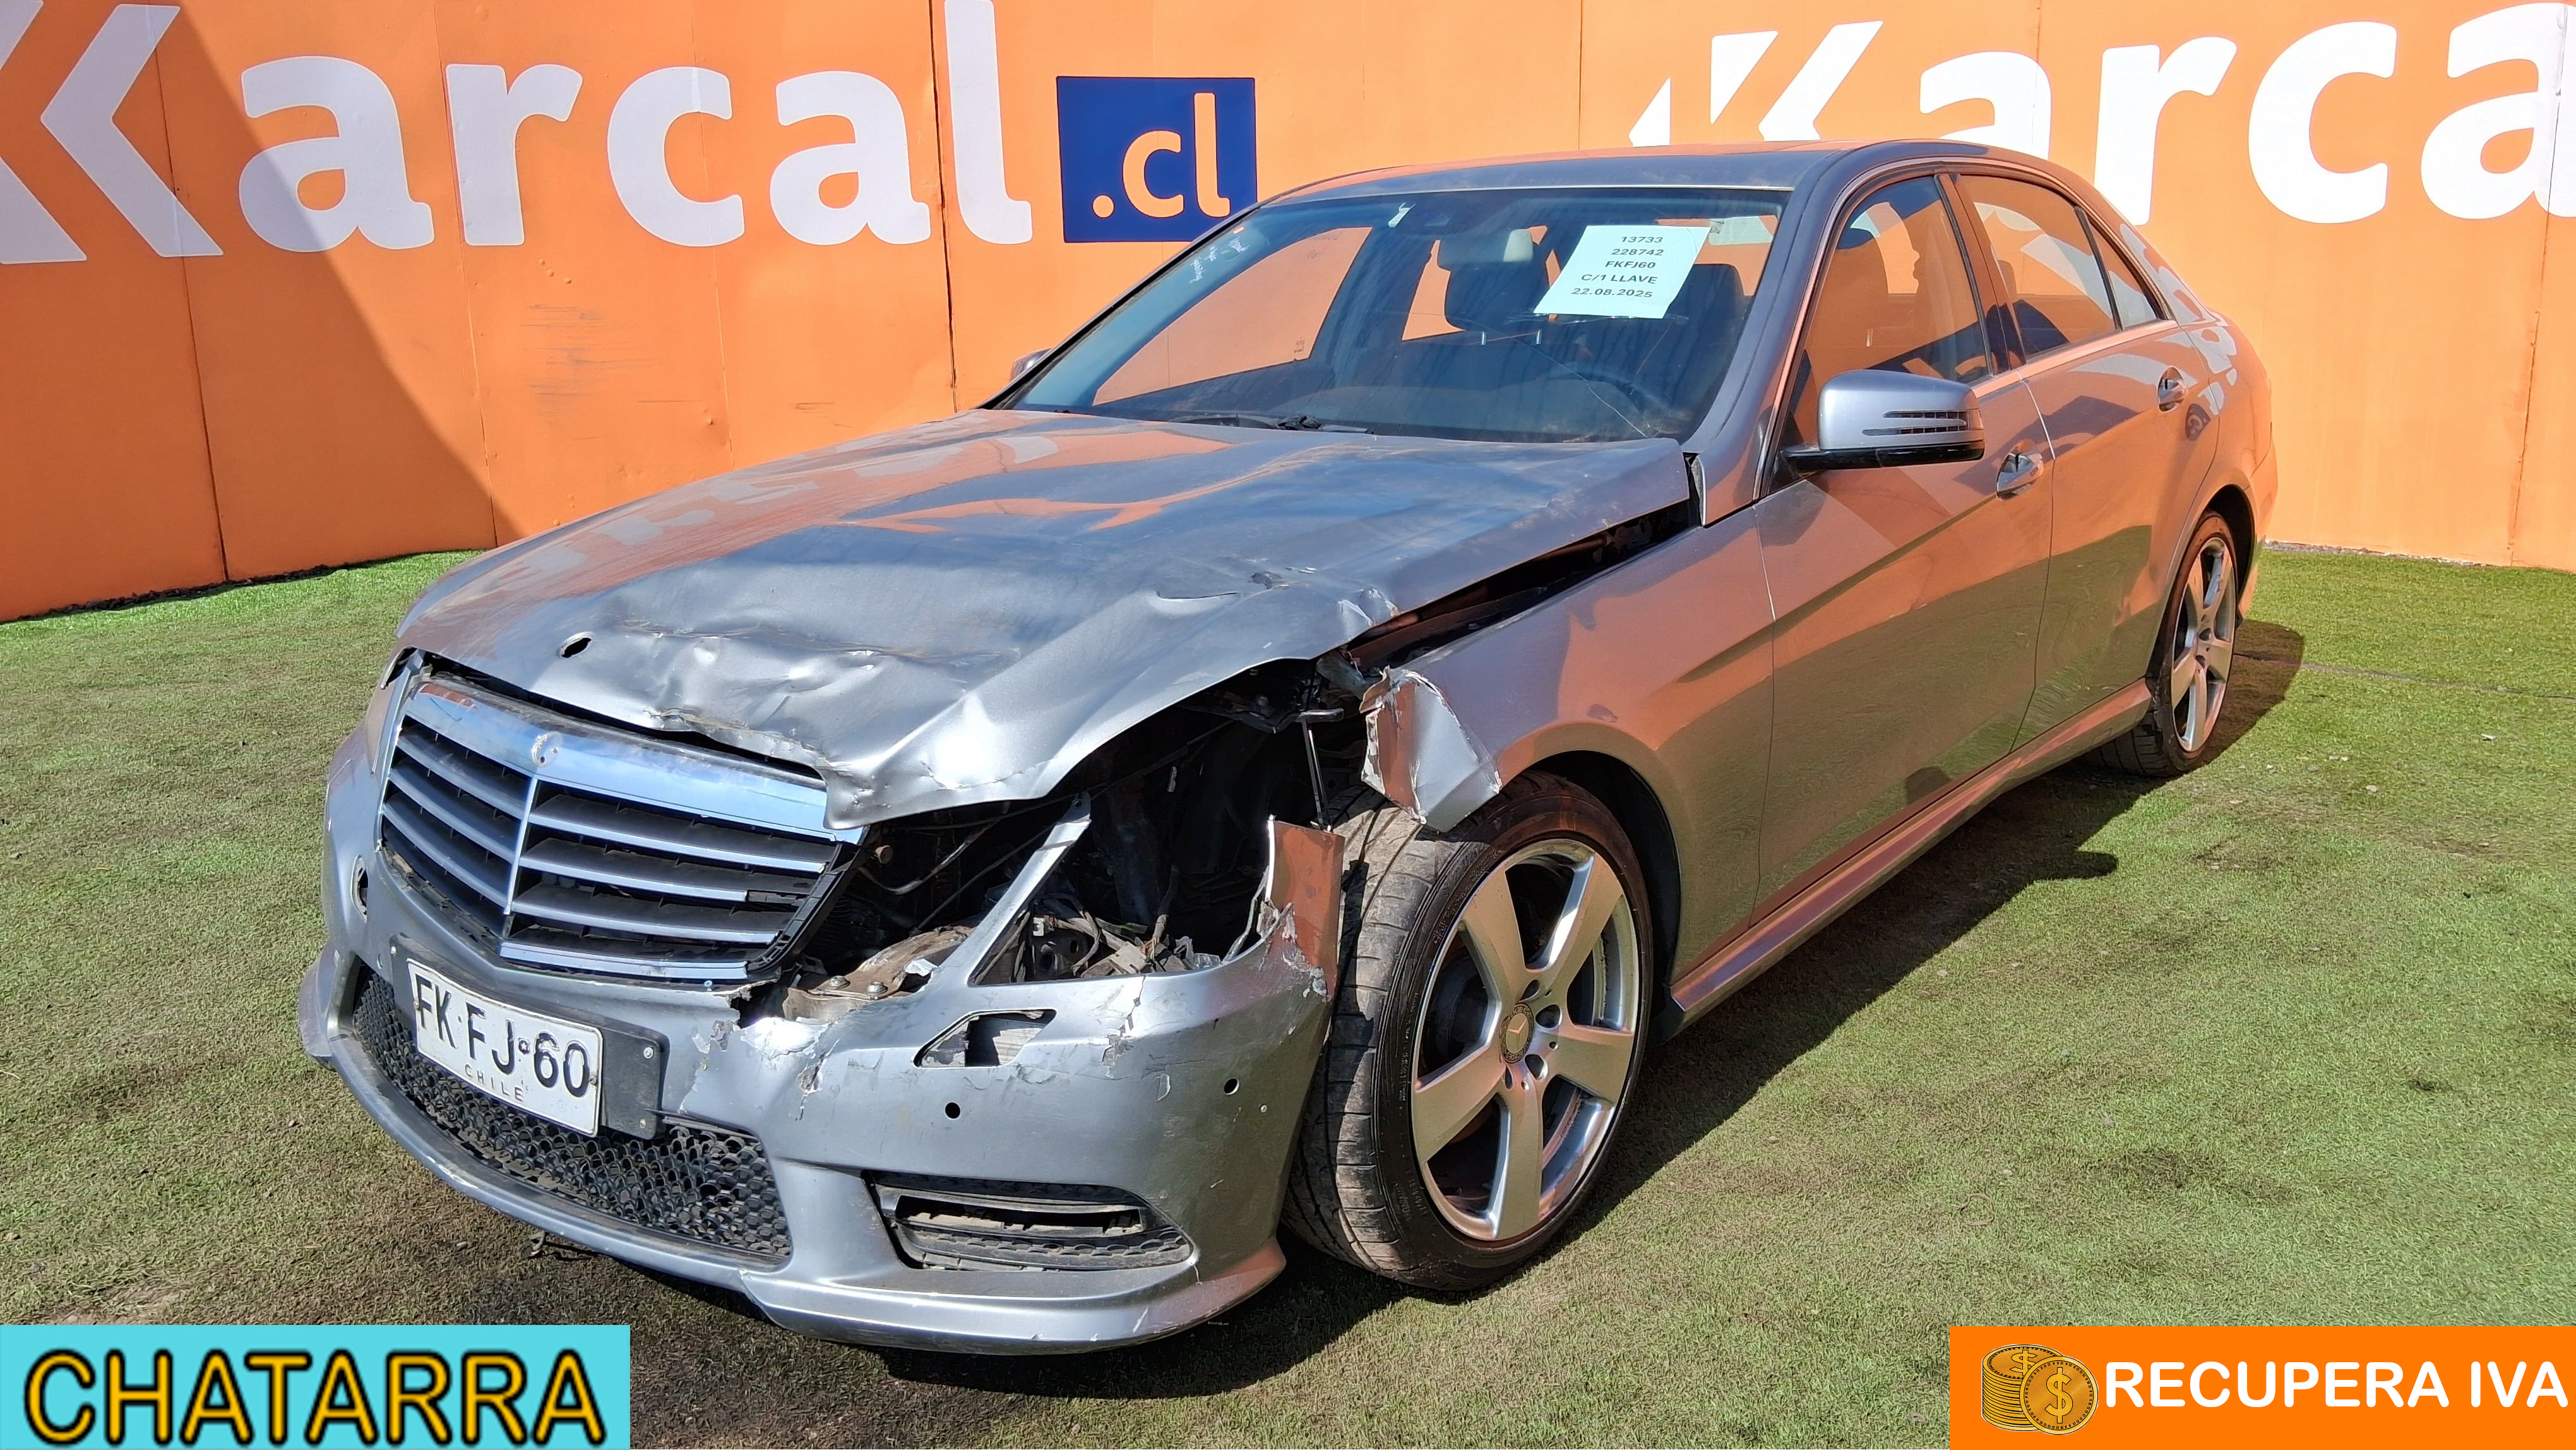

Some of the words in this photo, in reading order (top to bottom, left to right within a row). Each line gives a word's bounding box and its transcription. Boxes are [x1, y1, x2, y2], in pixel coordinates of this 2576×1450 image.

[1611, 248, 1664, 256] 228742
[1605, 260, 1656, 268] FKFJ60
[1610, 274, 1658, 284] LLAVE
[1570, 287, 1653, 298] 22.08.2025
[464, 1064, 524, 1102] CHILE
